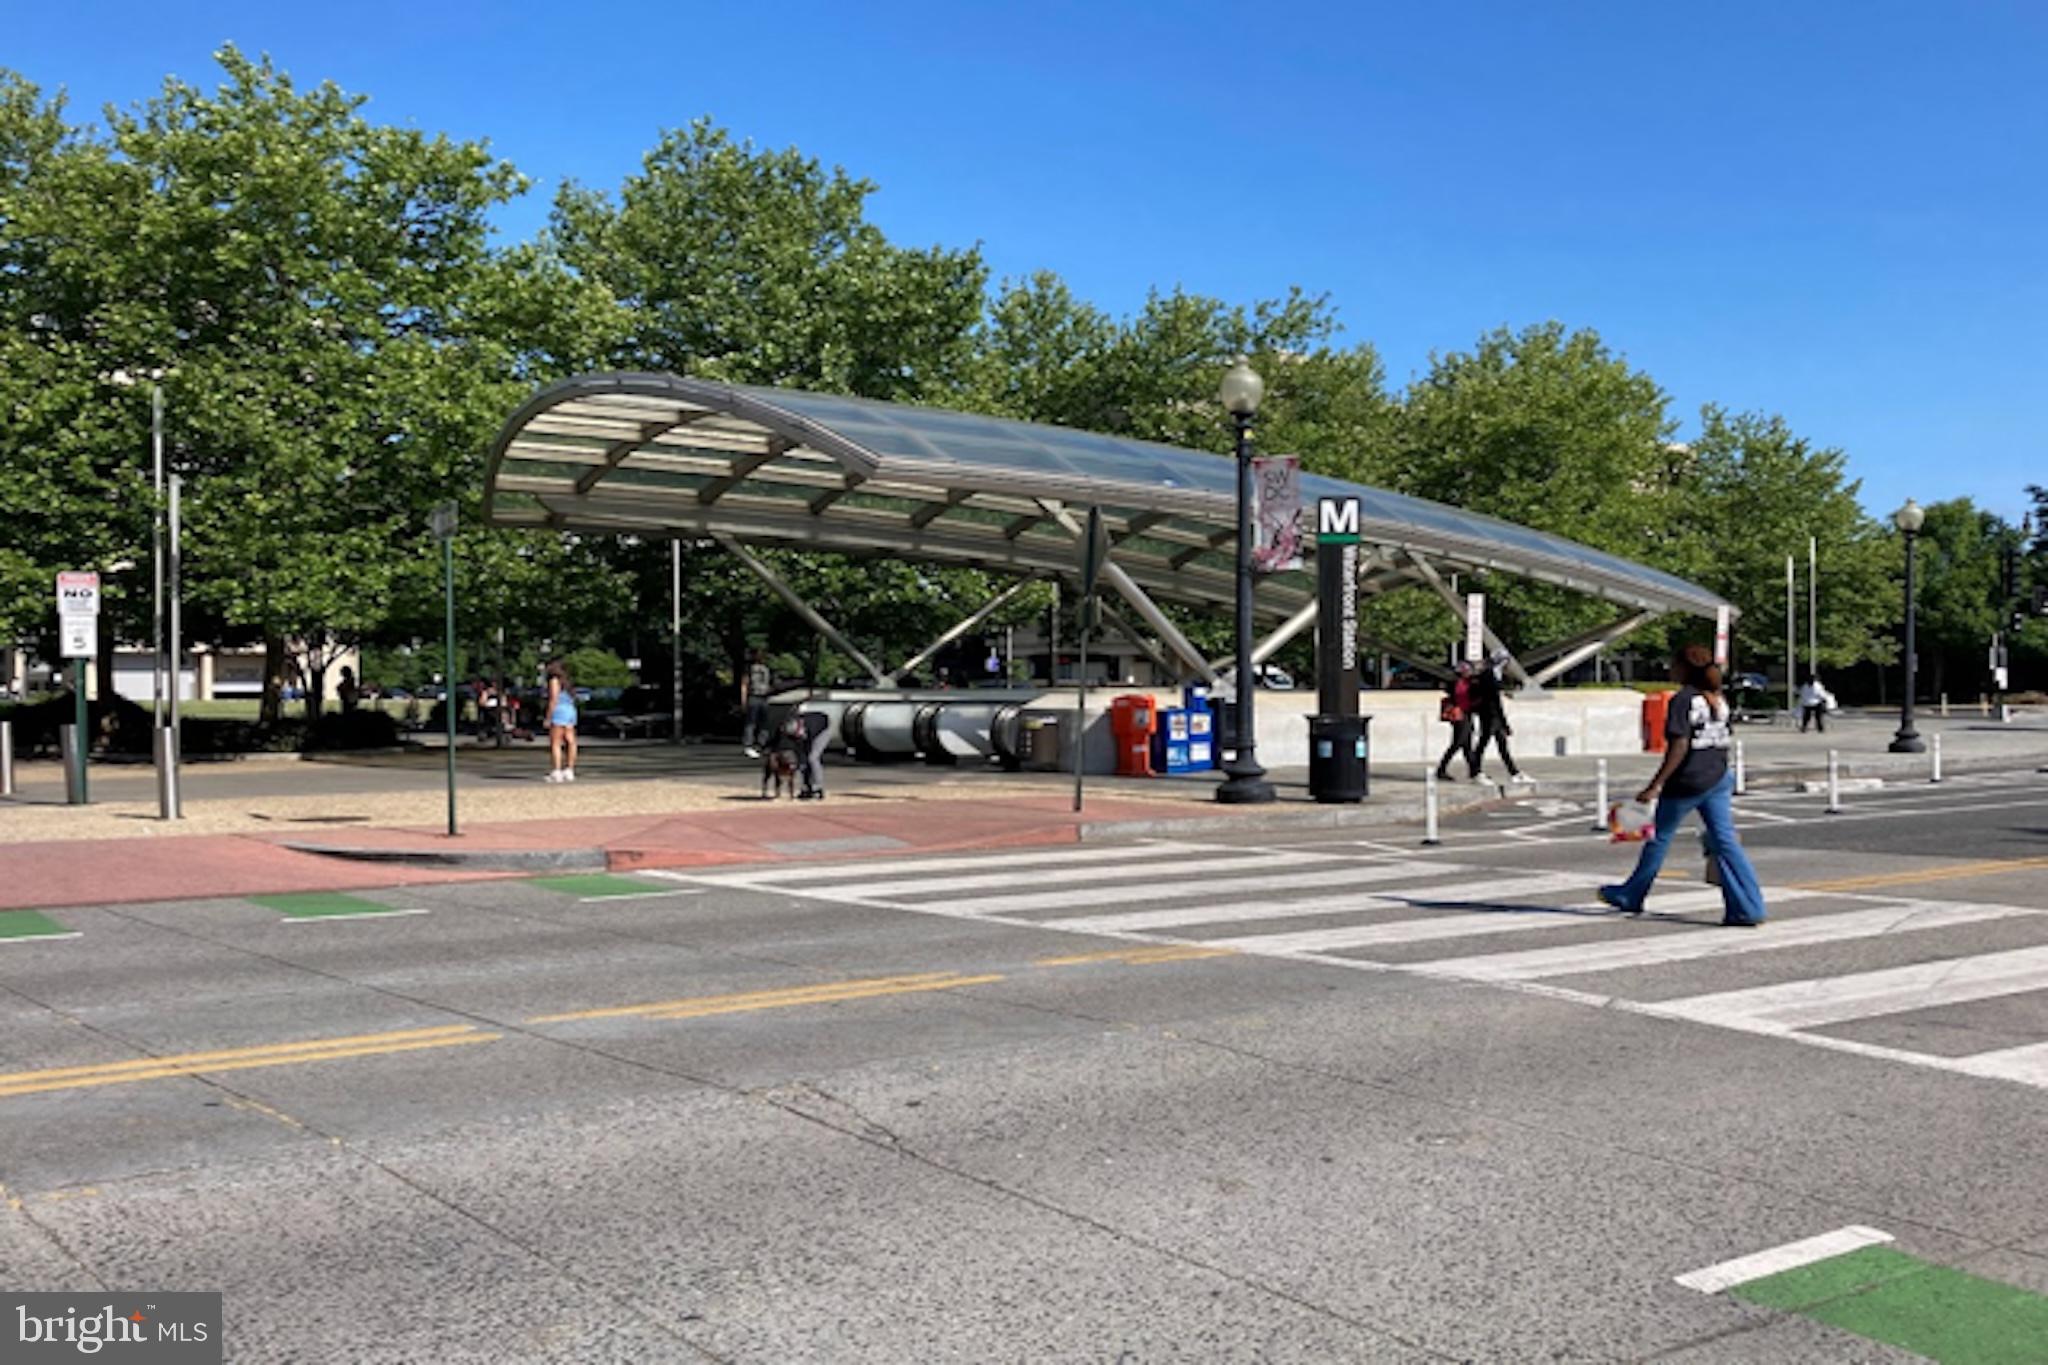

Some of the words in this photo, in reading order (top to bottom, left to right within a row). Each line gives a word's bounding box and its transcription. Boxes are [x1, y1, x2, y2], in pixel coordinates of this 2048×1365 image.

[1320, 499, 1359, 534] M
[64, 588, 93, 598] NO
[1341, 544, 1358, 617] Waterfront
[72, 636, 87, 649] 5
[1341, 619, 1358, 670] Station
